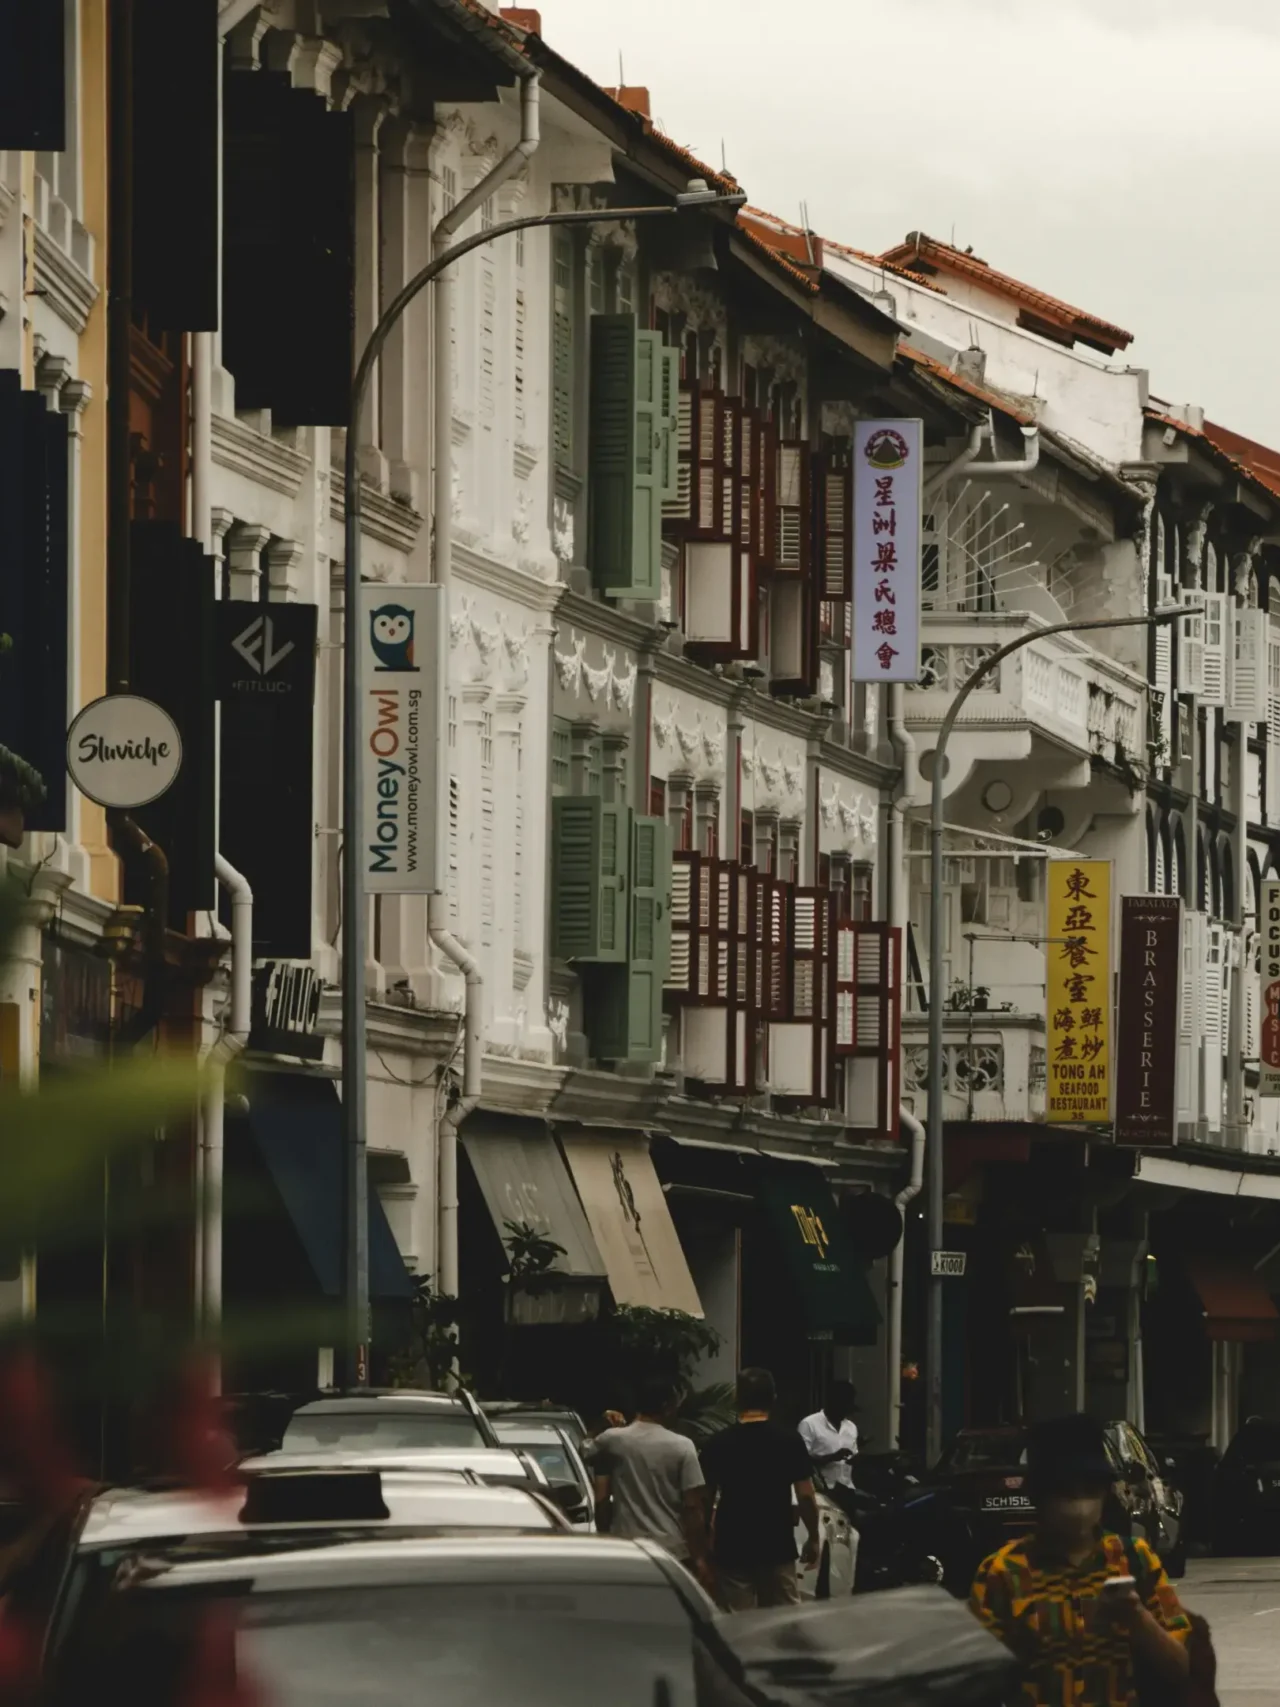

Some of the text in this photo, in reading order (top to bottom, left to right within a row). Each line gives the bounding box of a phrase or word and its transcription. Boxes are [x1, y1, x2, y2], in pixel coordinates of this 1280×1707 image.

[870, 475, 899, 670] 星洲梁氏總會
[369, 690, 406, 873] MoneyOwl
[405, 689, 422, 873] www.moneyowl.com.sg
[1059, 868, 1099, 1004] 東亞餐室
[1268, 888, 1280, 978] FOCUS
[1052, 1064, 1106, 1080] TONG AH
[1140, 929, 1158, 1108] BRASSERIE
[1269, 986, 1280, 1064] MUSIC
[1050, 1097, 1107, 1111] RESTAURANT
[1059, 1082, 1099, 1096] SEAFOOD
